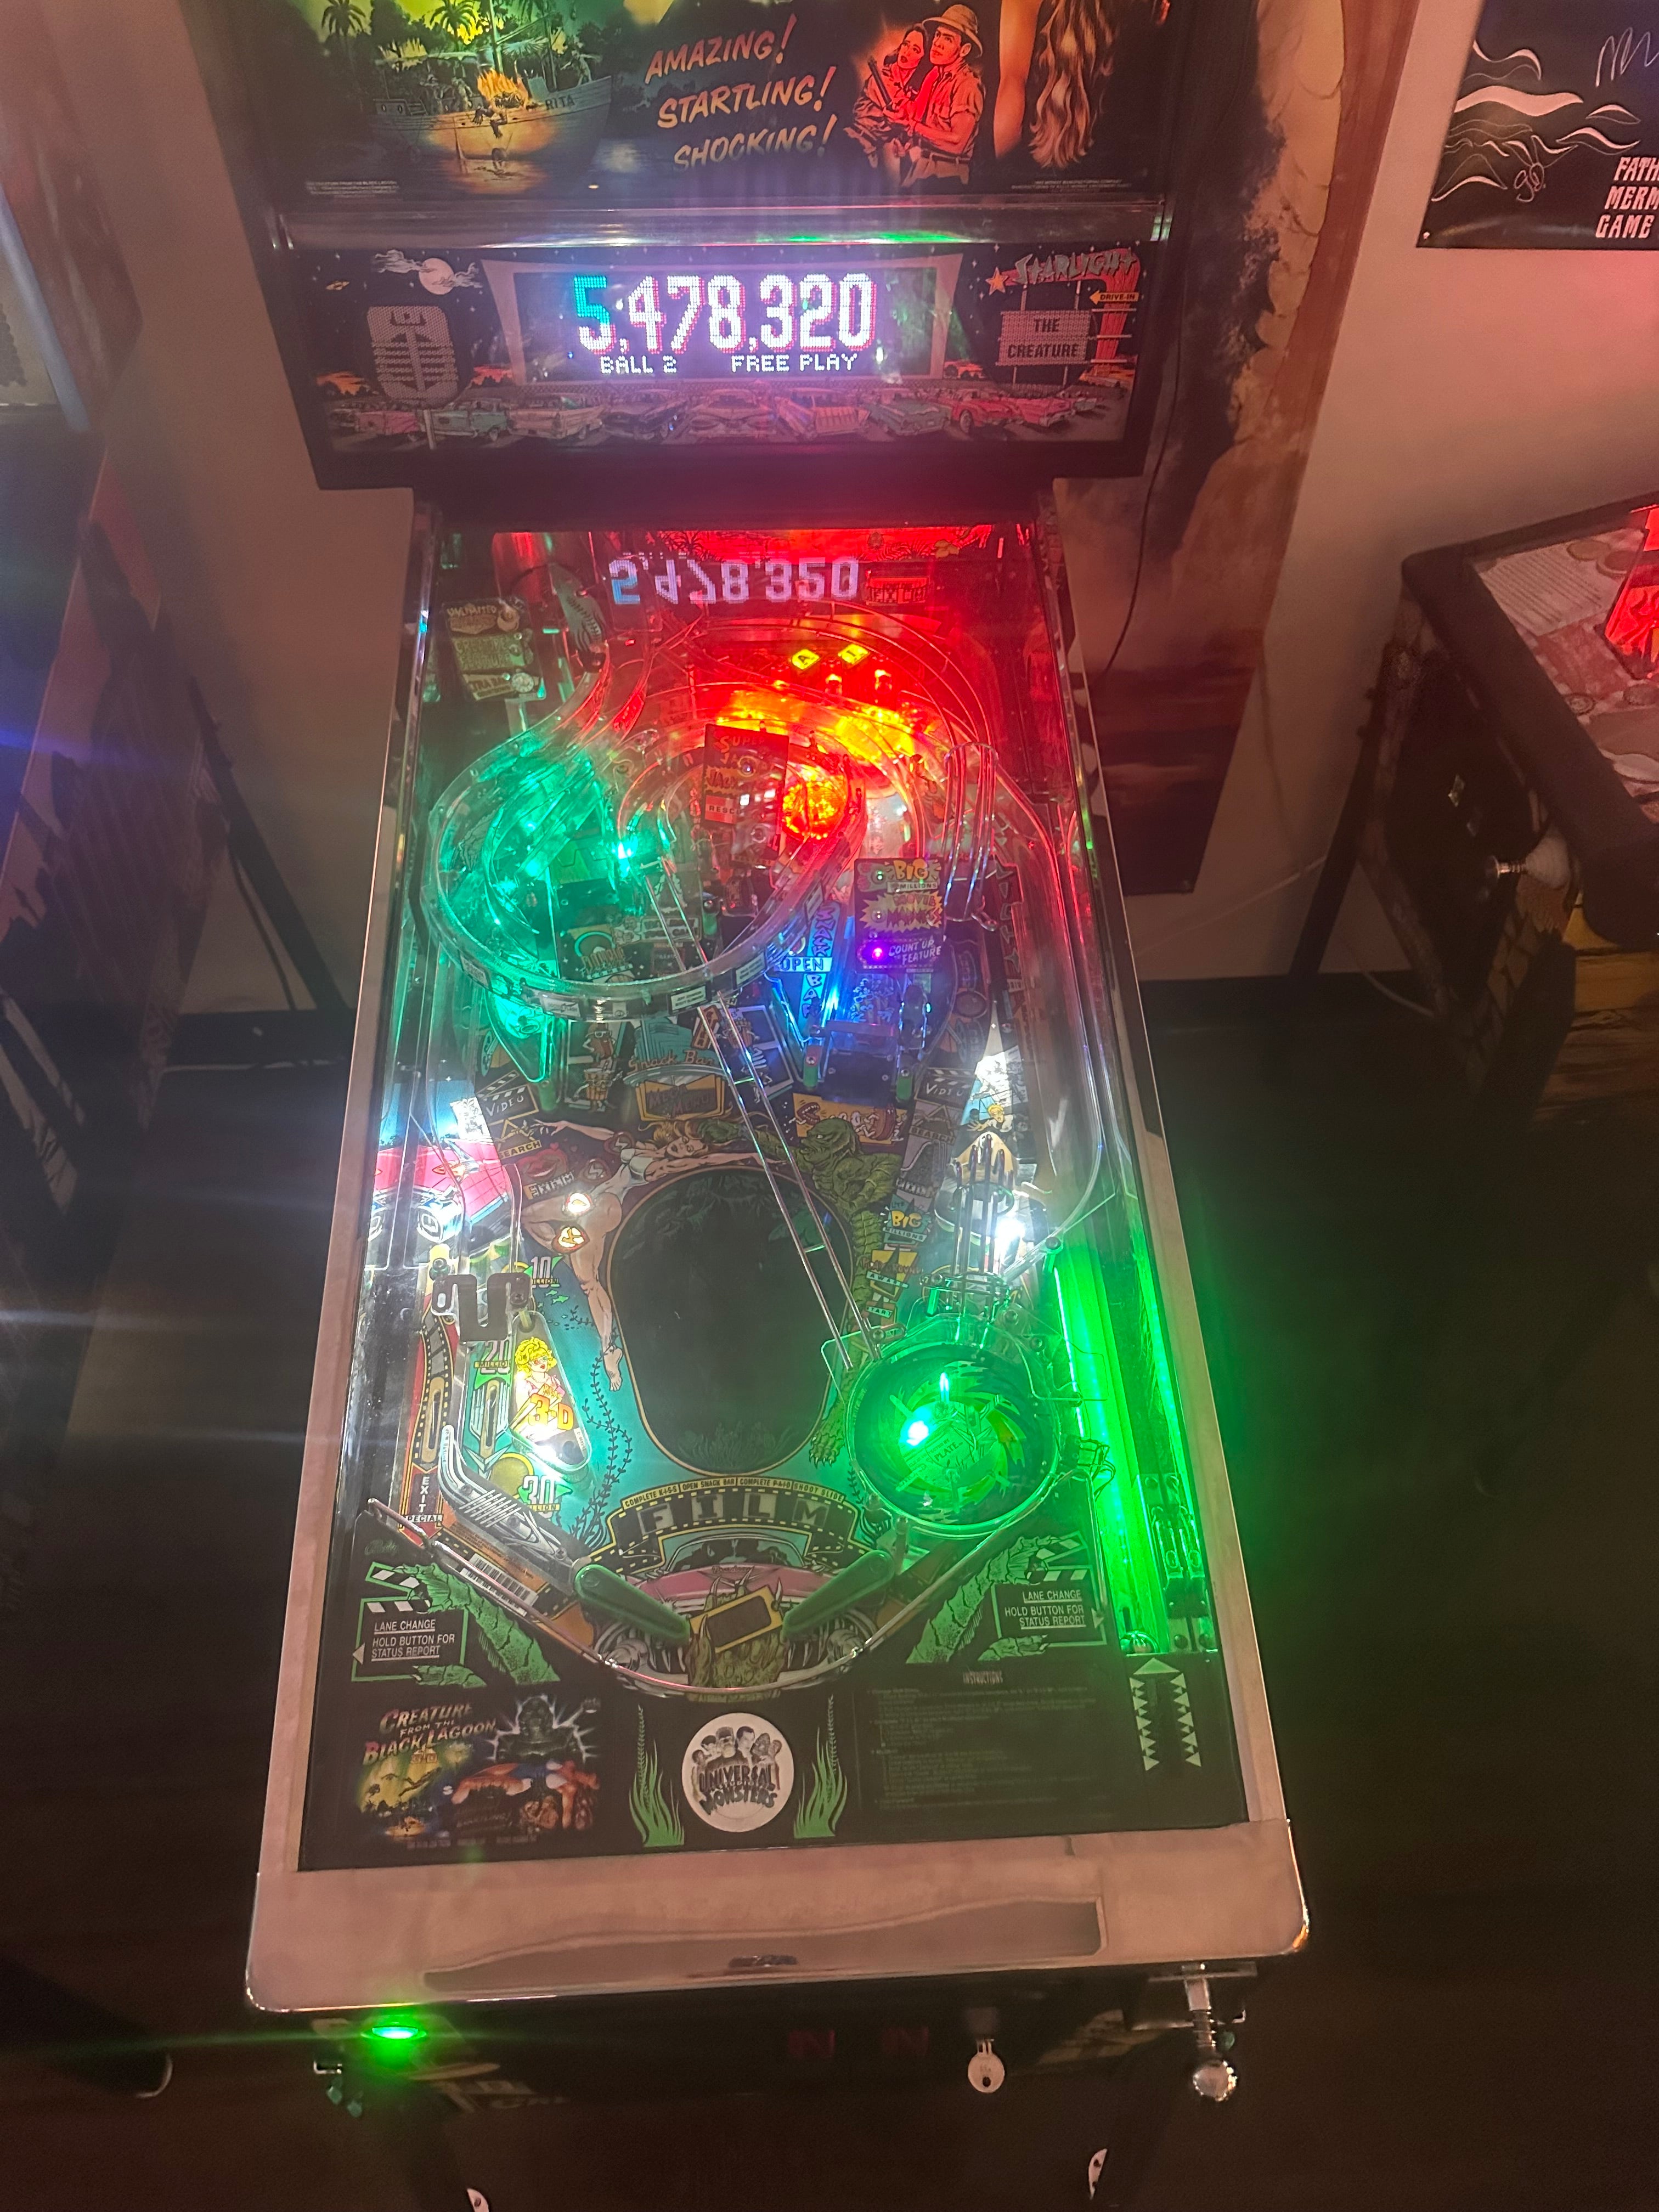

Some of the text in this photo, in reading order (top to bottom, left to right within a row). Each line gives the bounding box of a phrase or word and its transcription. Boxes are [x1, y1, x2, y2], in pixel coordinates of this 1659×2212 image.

[645, 13, 797, 84] AMAZING!
[545, 95, 575, 110] RITA
[657, 66, 837, 129] STARTLING!
[673, 114, 838, 171] SHOCKING!
[1614, 157, 1659, 180] FATH
[1595, 215, 1655, 238] GAME
[1013, 248, 1138, 284] STARLIGHT
[573, 273, 877, 354] 5,478,320
[1034, 318, 1060, 332] THE
[1008, 343, 1079, 358] CREATURE
[600, 353, 857, 374] BALL 2 FREE PLAY
[708, 805, 742, 815] RESCU
[893, 859, 928, 881] BIG
[889, 938, 934, 957] COUNT UP
[901, 946, 941, 965] FEATURE
[781, 958, 824, 971] OPEN
[628, 1049, 677, 1071] Snack
[486, 1096, 524, 1116] VIDEO
[911, 1126, 956, 1145] SEARCH
[499, 1141, 541, 1158] SEARCH
[891, 1210, 923, 1228] BIG
[884, 1227, 924, 1242] MILLIONS
[531, 1256, 551, 1288] 10
[527, 1393, 574, 1430] 3-D
[934, 1442, 960, 1462] PLATE
[682, 1481, 699, 1490] OPEN
[701, 1479, 720, 1488] SNACK
[740, 1478, 791, 1489] COMPLETE P-A-I-D
[794, 1483, 843, 1502] SHOOT SLIDE
[419, 1476, 430, 1514] EXIT
[522, 1475, 556, 1518] 30
[625, 1485, 677, 1508] COMPLETE K-I-S-S
[407, 1515, 442, 1523] PECIAL
[1023, 1589, 1082, 1600] LANE CHANGE
[1005, 1604, 1084, 1617] HOLD BUTTON FOR
[374, 1619, 436, 1632] LANE CHANGE
[1019, 1615, 1085, 1627] STATUS REPORT
[373, 1634, 454, 1647] HOLD BUTTON FOR
[371, 1646, 440, 1658] STATUS REPORT
[963, 1671, 1003, 1685] INSTRUCTIONS
[379, 1703, 473, 1734] CREATURE
[400, 1724, 430, 1738] FROM
[363, 1733, 424, 1765] BLACK
[426, 1718, 496, 1748] LAGOON
[699, 1764, 772, 1793] UNIVERSAL
[699, 1785, 777, 1815] MONSTERS
